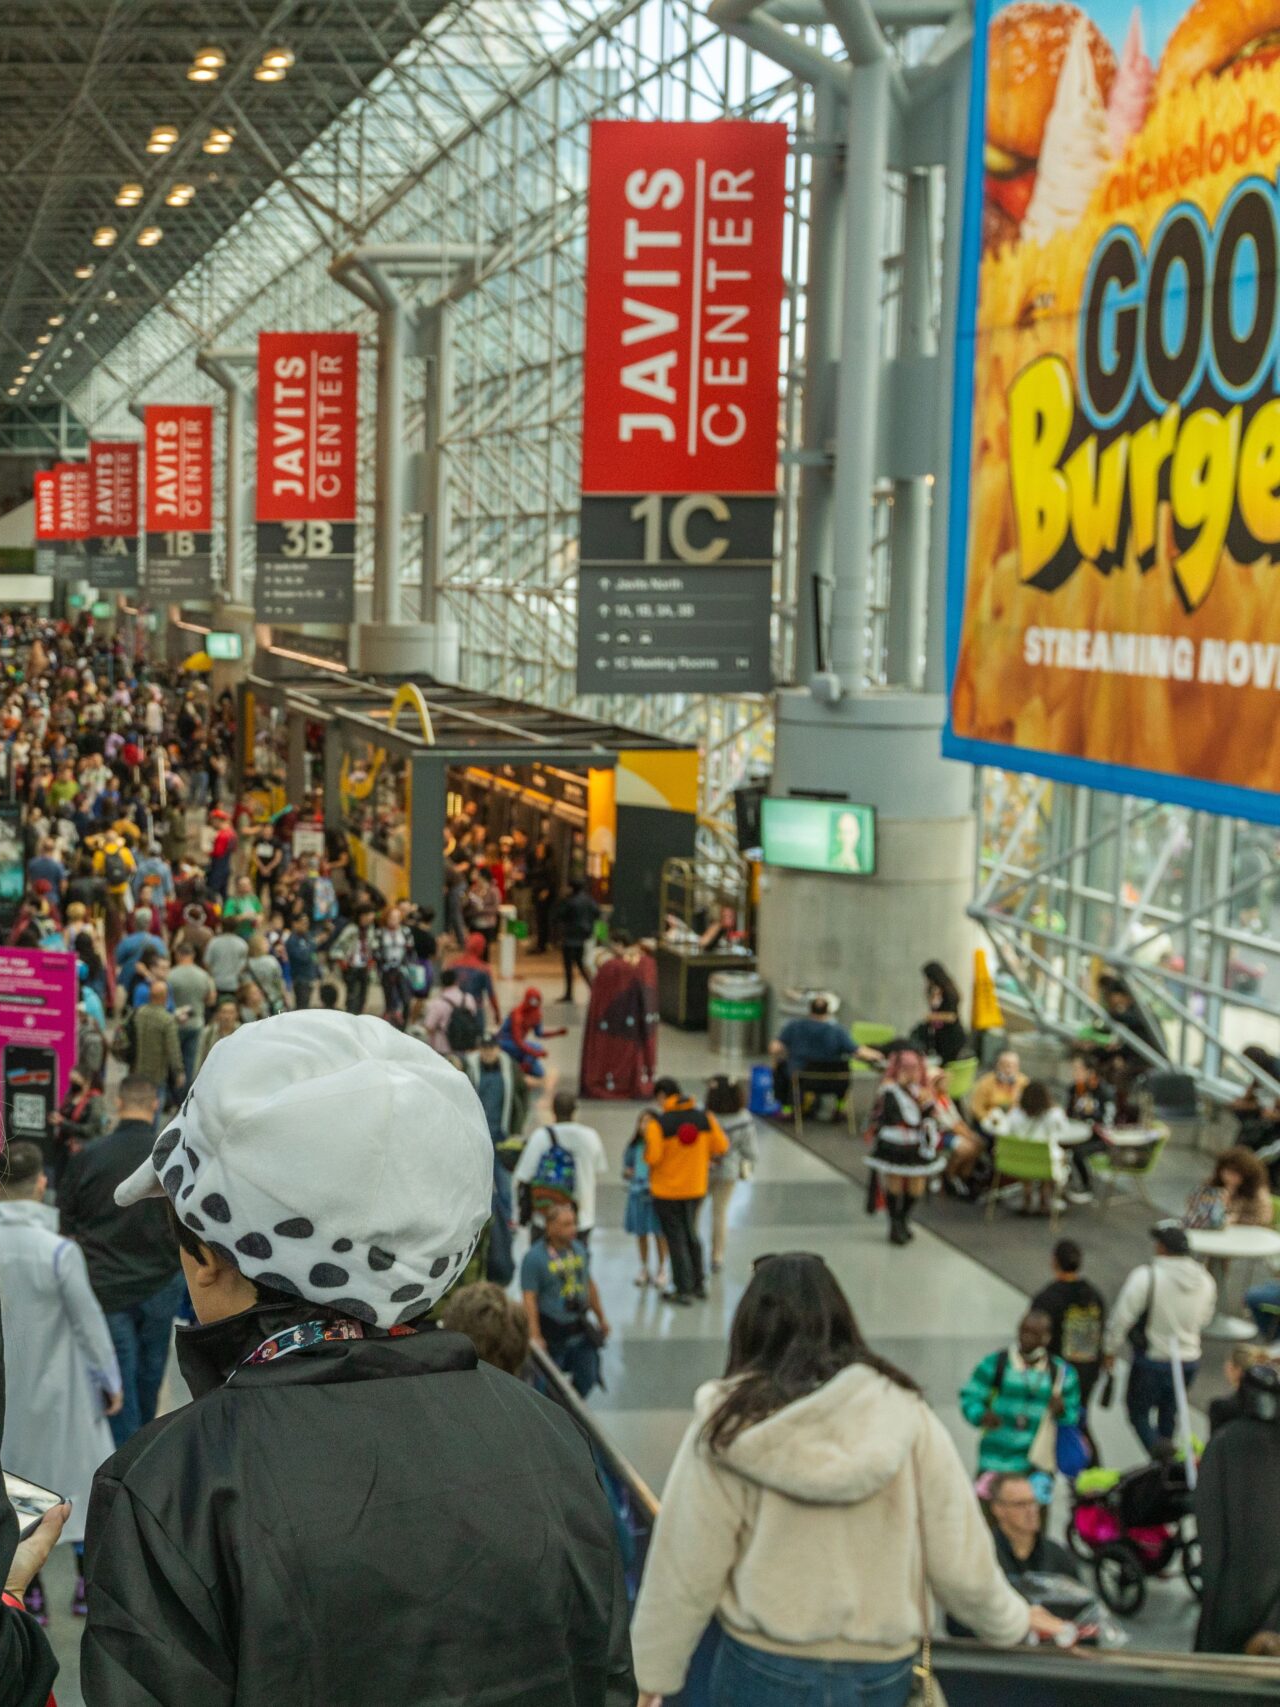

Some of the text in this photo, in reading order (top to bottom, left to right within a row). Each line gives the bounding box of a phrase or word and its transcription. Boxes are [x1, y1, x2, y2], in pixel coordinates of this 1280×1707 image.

[618, 167, 685, 443] JAVITS
[701, 168, 755, 446] CENTER
[1078, 177, 1280, 428] GOO
[156, 420, 180, 516] JAVITS
[183, 418, 204, 517] CENTER
[273, 356, 306, 497] JAVITS
[315, 355, 343, 498] CENTER
[95, 452, 114, 526] JAVITS
[630, 494, 732, 564] 1C
[162, 531, 196, 557] 1B
[281, 520, 333, 558] 3B
[615, 577, 684, 591] Javits North
[630, 656, 677, 673] Meeting
[678, 656, 720, 670] Rooms
[1023, 625, 1280, 690] STREAMING NOV
